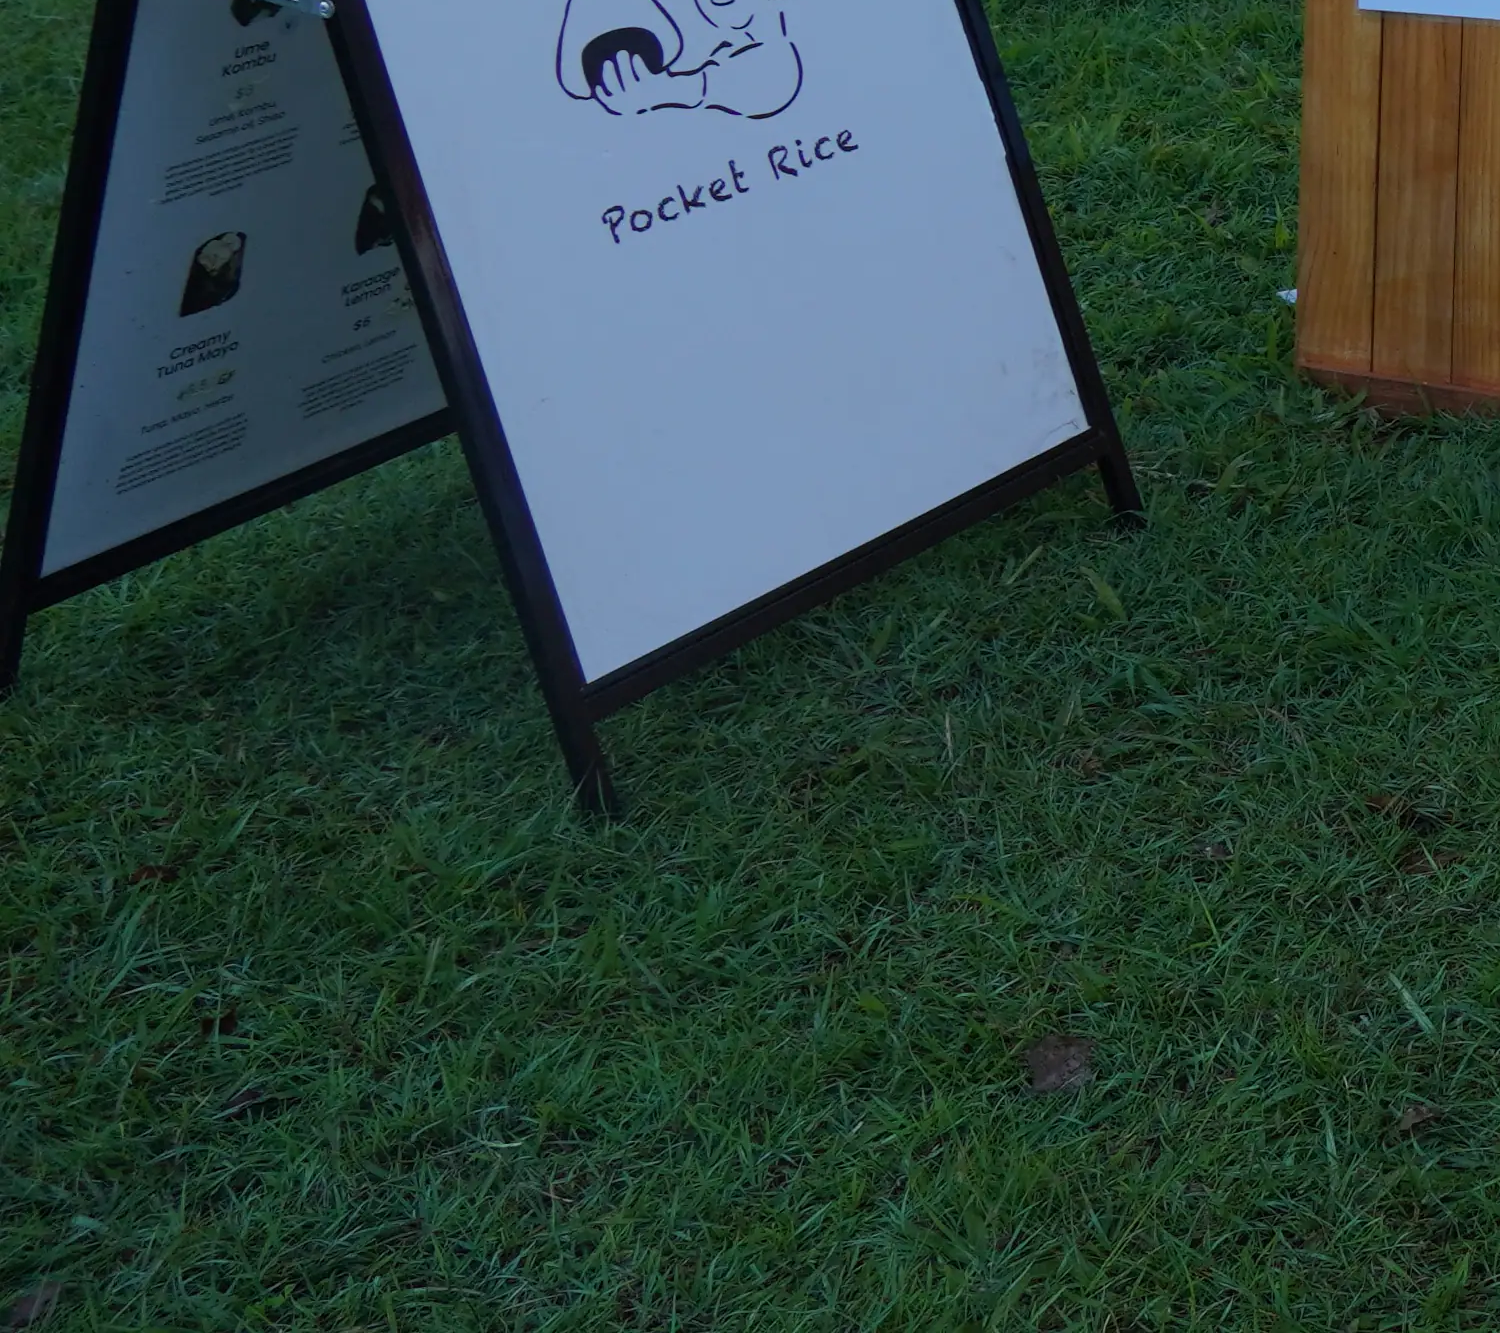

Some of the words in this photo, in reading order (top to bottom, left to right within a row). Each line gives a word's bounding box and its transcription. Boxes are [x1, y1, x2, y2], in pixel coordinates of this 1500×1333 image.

[235, 40, 271, 59] Ume
[221, 53, 277, 77] Kombu
[601, 160, 752, 245] Pocket
[767, 126, 860, 186] Rice
[345, 283, 392, 308] Lemon
[170, 330, 232, 360] Creamy
[157, 357, 194, 379] Tuna
[199, 341, 239, 364] Mayo
